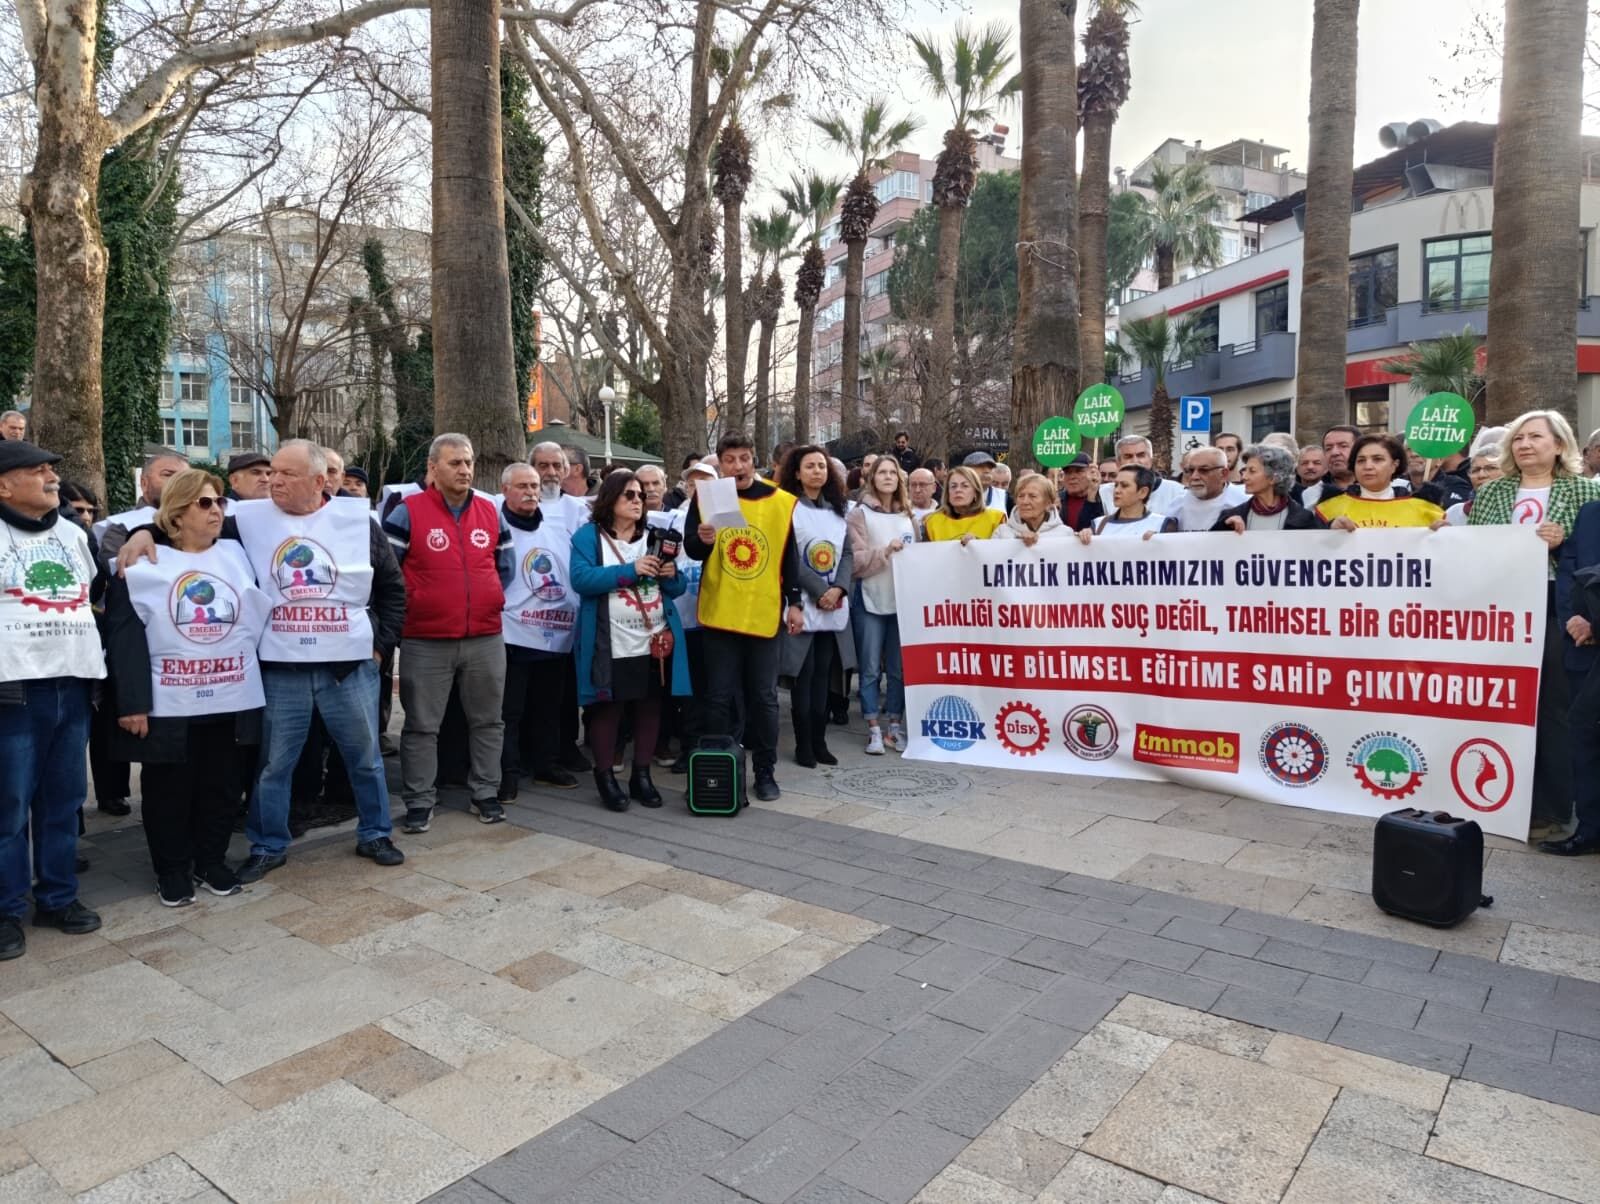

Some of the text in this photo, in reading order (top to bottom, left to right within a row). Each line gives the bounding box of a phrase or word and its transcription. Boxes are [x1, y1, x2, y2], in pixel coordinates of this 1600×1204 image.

[1084, 393, 1112, 410] LAİK
[1077, 410, 1120, 428] YAŞAM
[1187, 400, 1204, 429] P
[1421, 404, 1460, 424] LAİK
[1043, 425, 1071, 441] LAİK
[1408, 423, 1466, 444] EĞİTİM
[1036, 438, 1077, 455] EĞİTİM
[983, 553, 1431, 587] LAİKLİK HAKLARIMIZIN GÜVENCESİDİR!
[272, 602, 348, 621] EMEKLİ
[923, 598, 993, 628] LAİKLİĞİ
[998, 603, 1106, 629] SAVUNMAK
[1112, 605, 1149, 637] SUÇ
[1156, 598, 1218, 635] DEĞİL,
[1226, 601, 1331, 636] TARİHSEL
[1339, 602, 1379, 638] BİR
[1388, 602, 1514, 643] GÖREVDİR
[161, 651, 245, 675] EMEKLİ
[937, 648, 1517, 709] LAİK VE BİLİMSEL EĞİTİME SAHİP ÇIKIYORUZ!
[921, 719, 987, 740] KESK
[1138, 730, 1235, 758] tmmob
